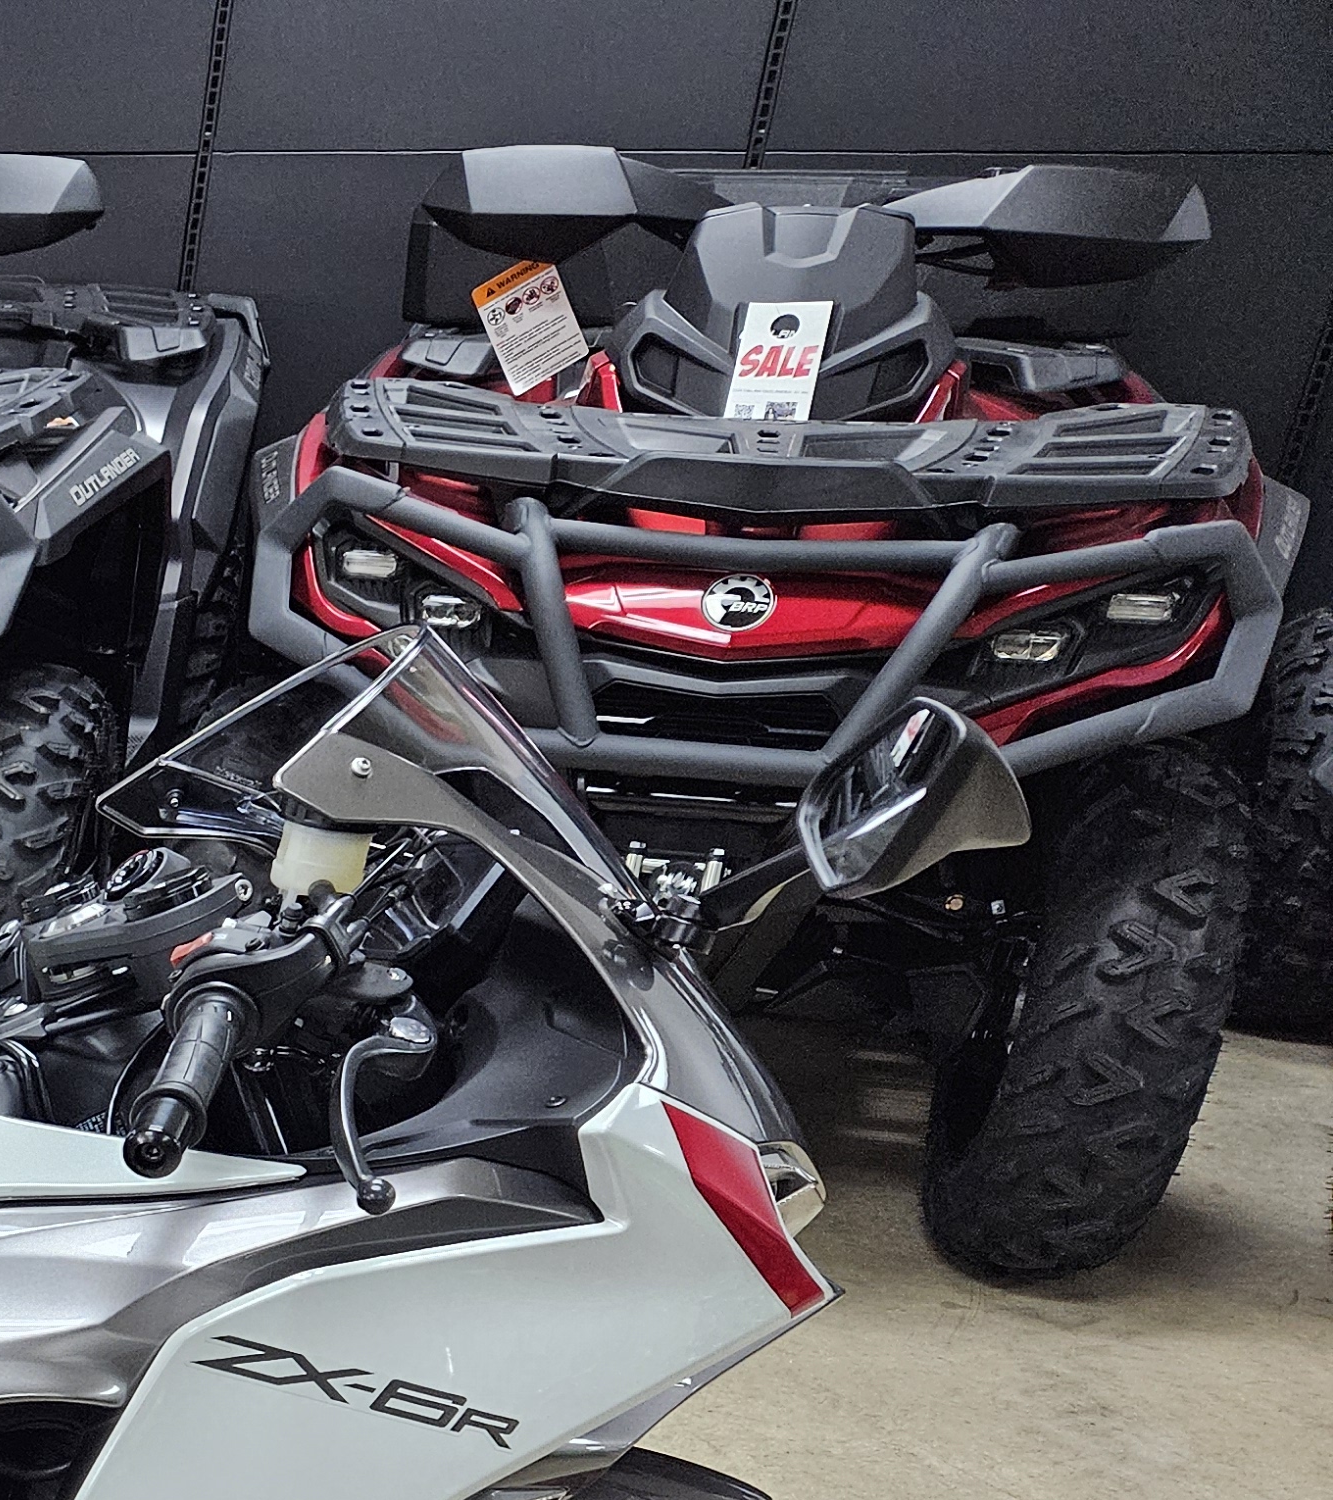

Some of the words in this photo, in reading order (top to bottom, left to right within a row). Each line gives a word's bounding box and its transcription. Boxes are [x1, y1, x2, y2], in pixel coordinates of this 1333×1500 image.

[495, 261, 541, 289] WARNING
[738, 344, 820, 378] SALE
[69, 447, 141, 507] OUTLANDER
[728, 601, 769, 614] BRP
